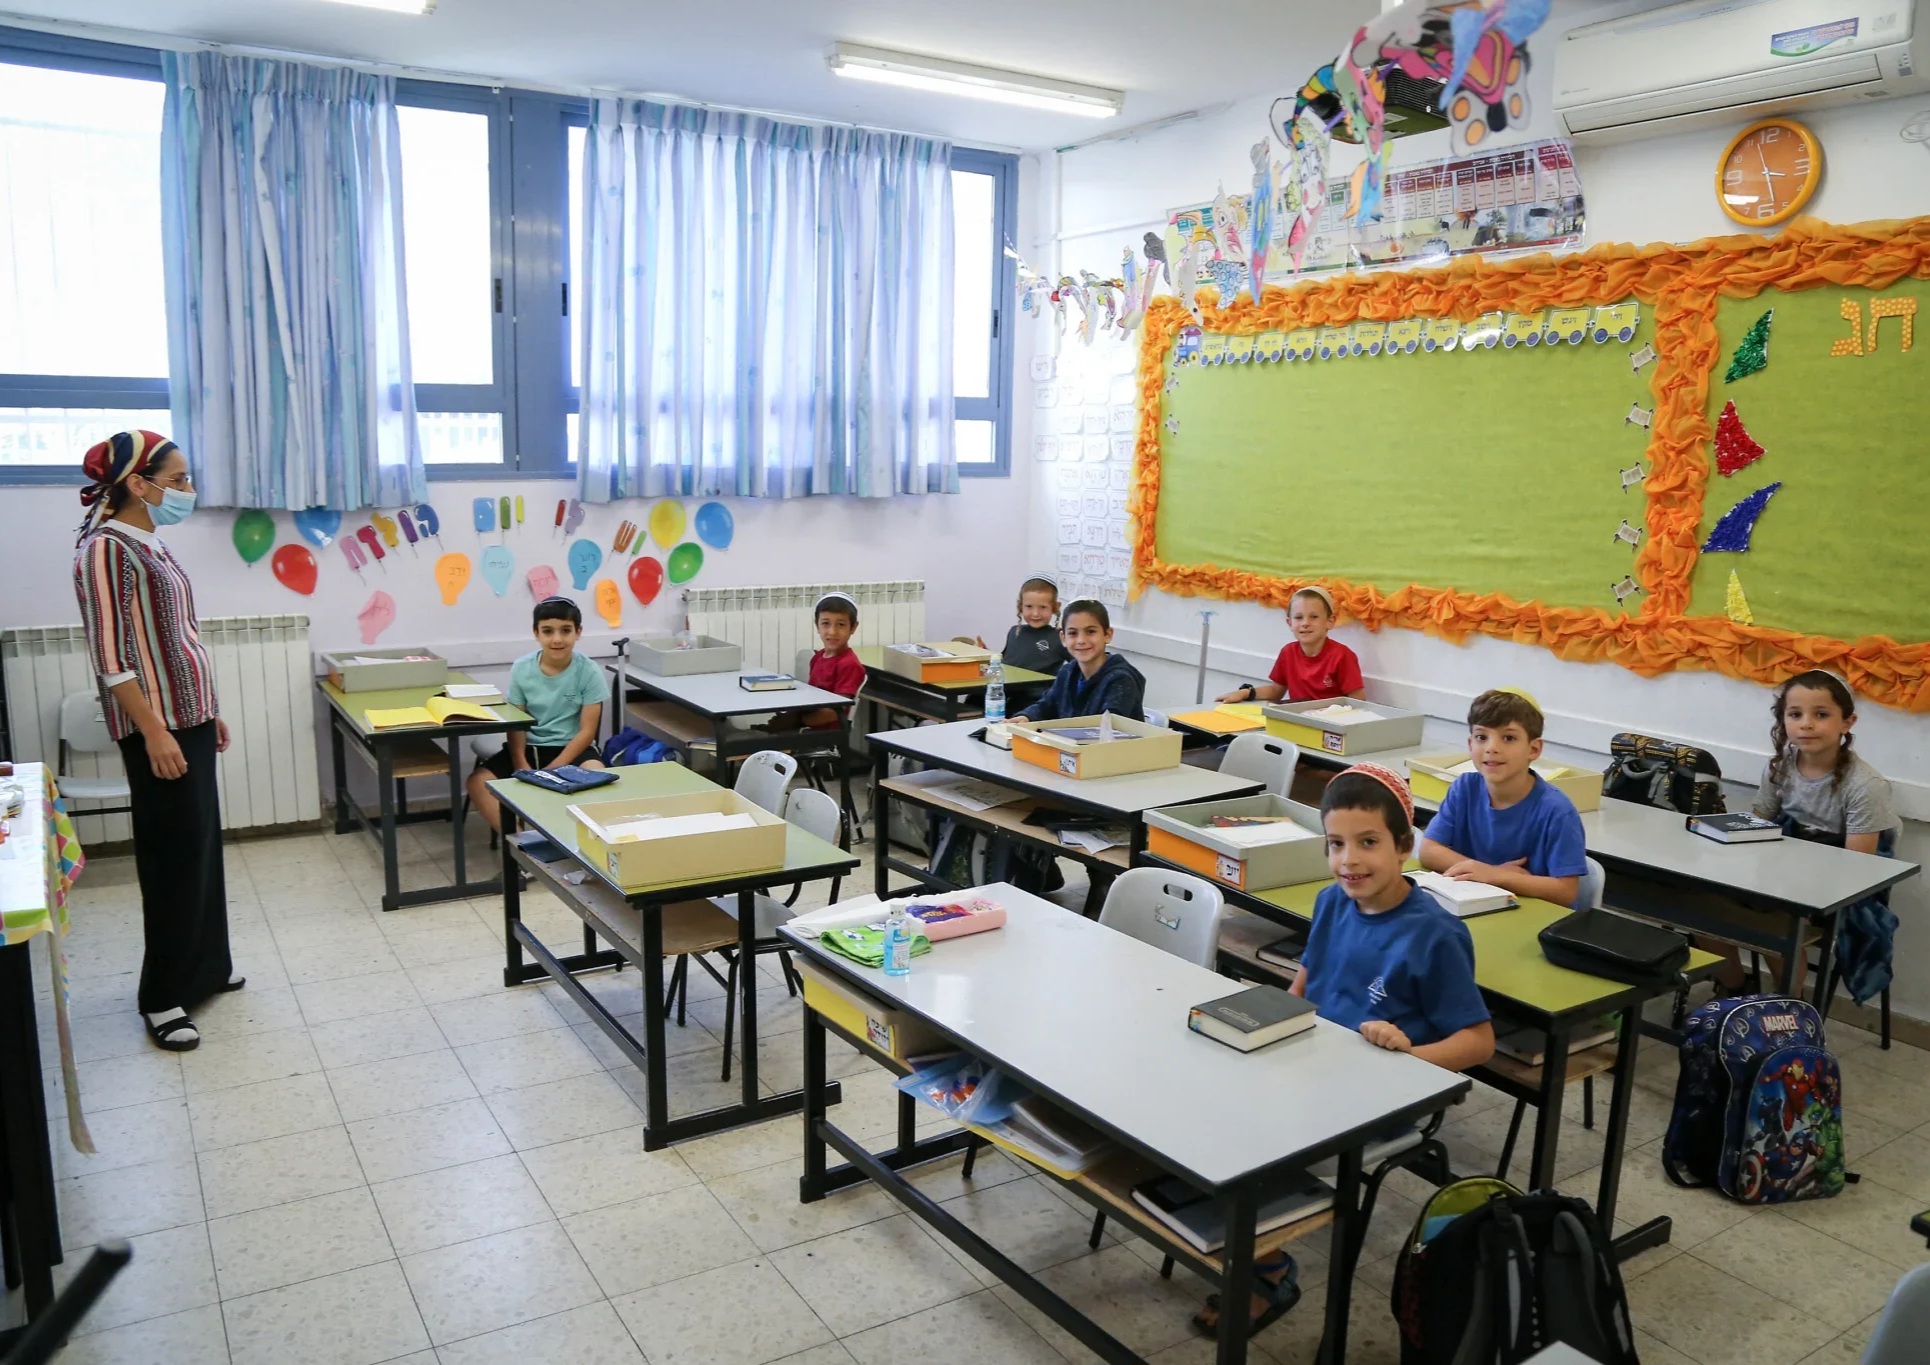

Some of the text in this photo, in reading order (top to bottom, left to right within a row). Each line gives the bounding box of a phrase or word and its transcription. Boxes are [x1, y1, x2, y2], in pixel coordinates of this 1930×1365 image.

[1759, 127, 1780, 144] 12
[1798, 143, 1806, 152] 2
[1734, 155, 1743, 163] 10
[1794, 158, 1810, 176] 3
[1726, 170, 1743, 186] 9
[1743, 207, 1750, 215] 7
[1757, 202, 1775, 219] 6
[1782, 202, 1789, 210] 5
[1830, 295, 1917, 357] חג
[473, 495, 525, 532] יום
[339, 504, 439, 569] הולדת
[1762, 1013, 1799, 1032] MARVEL
